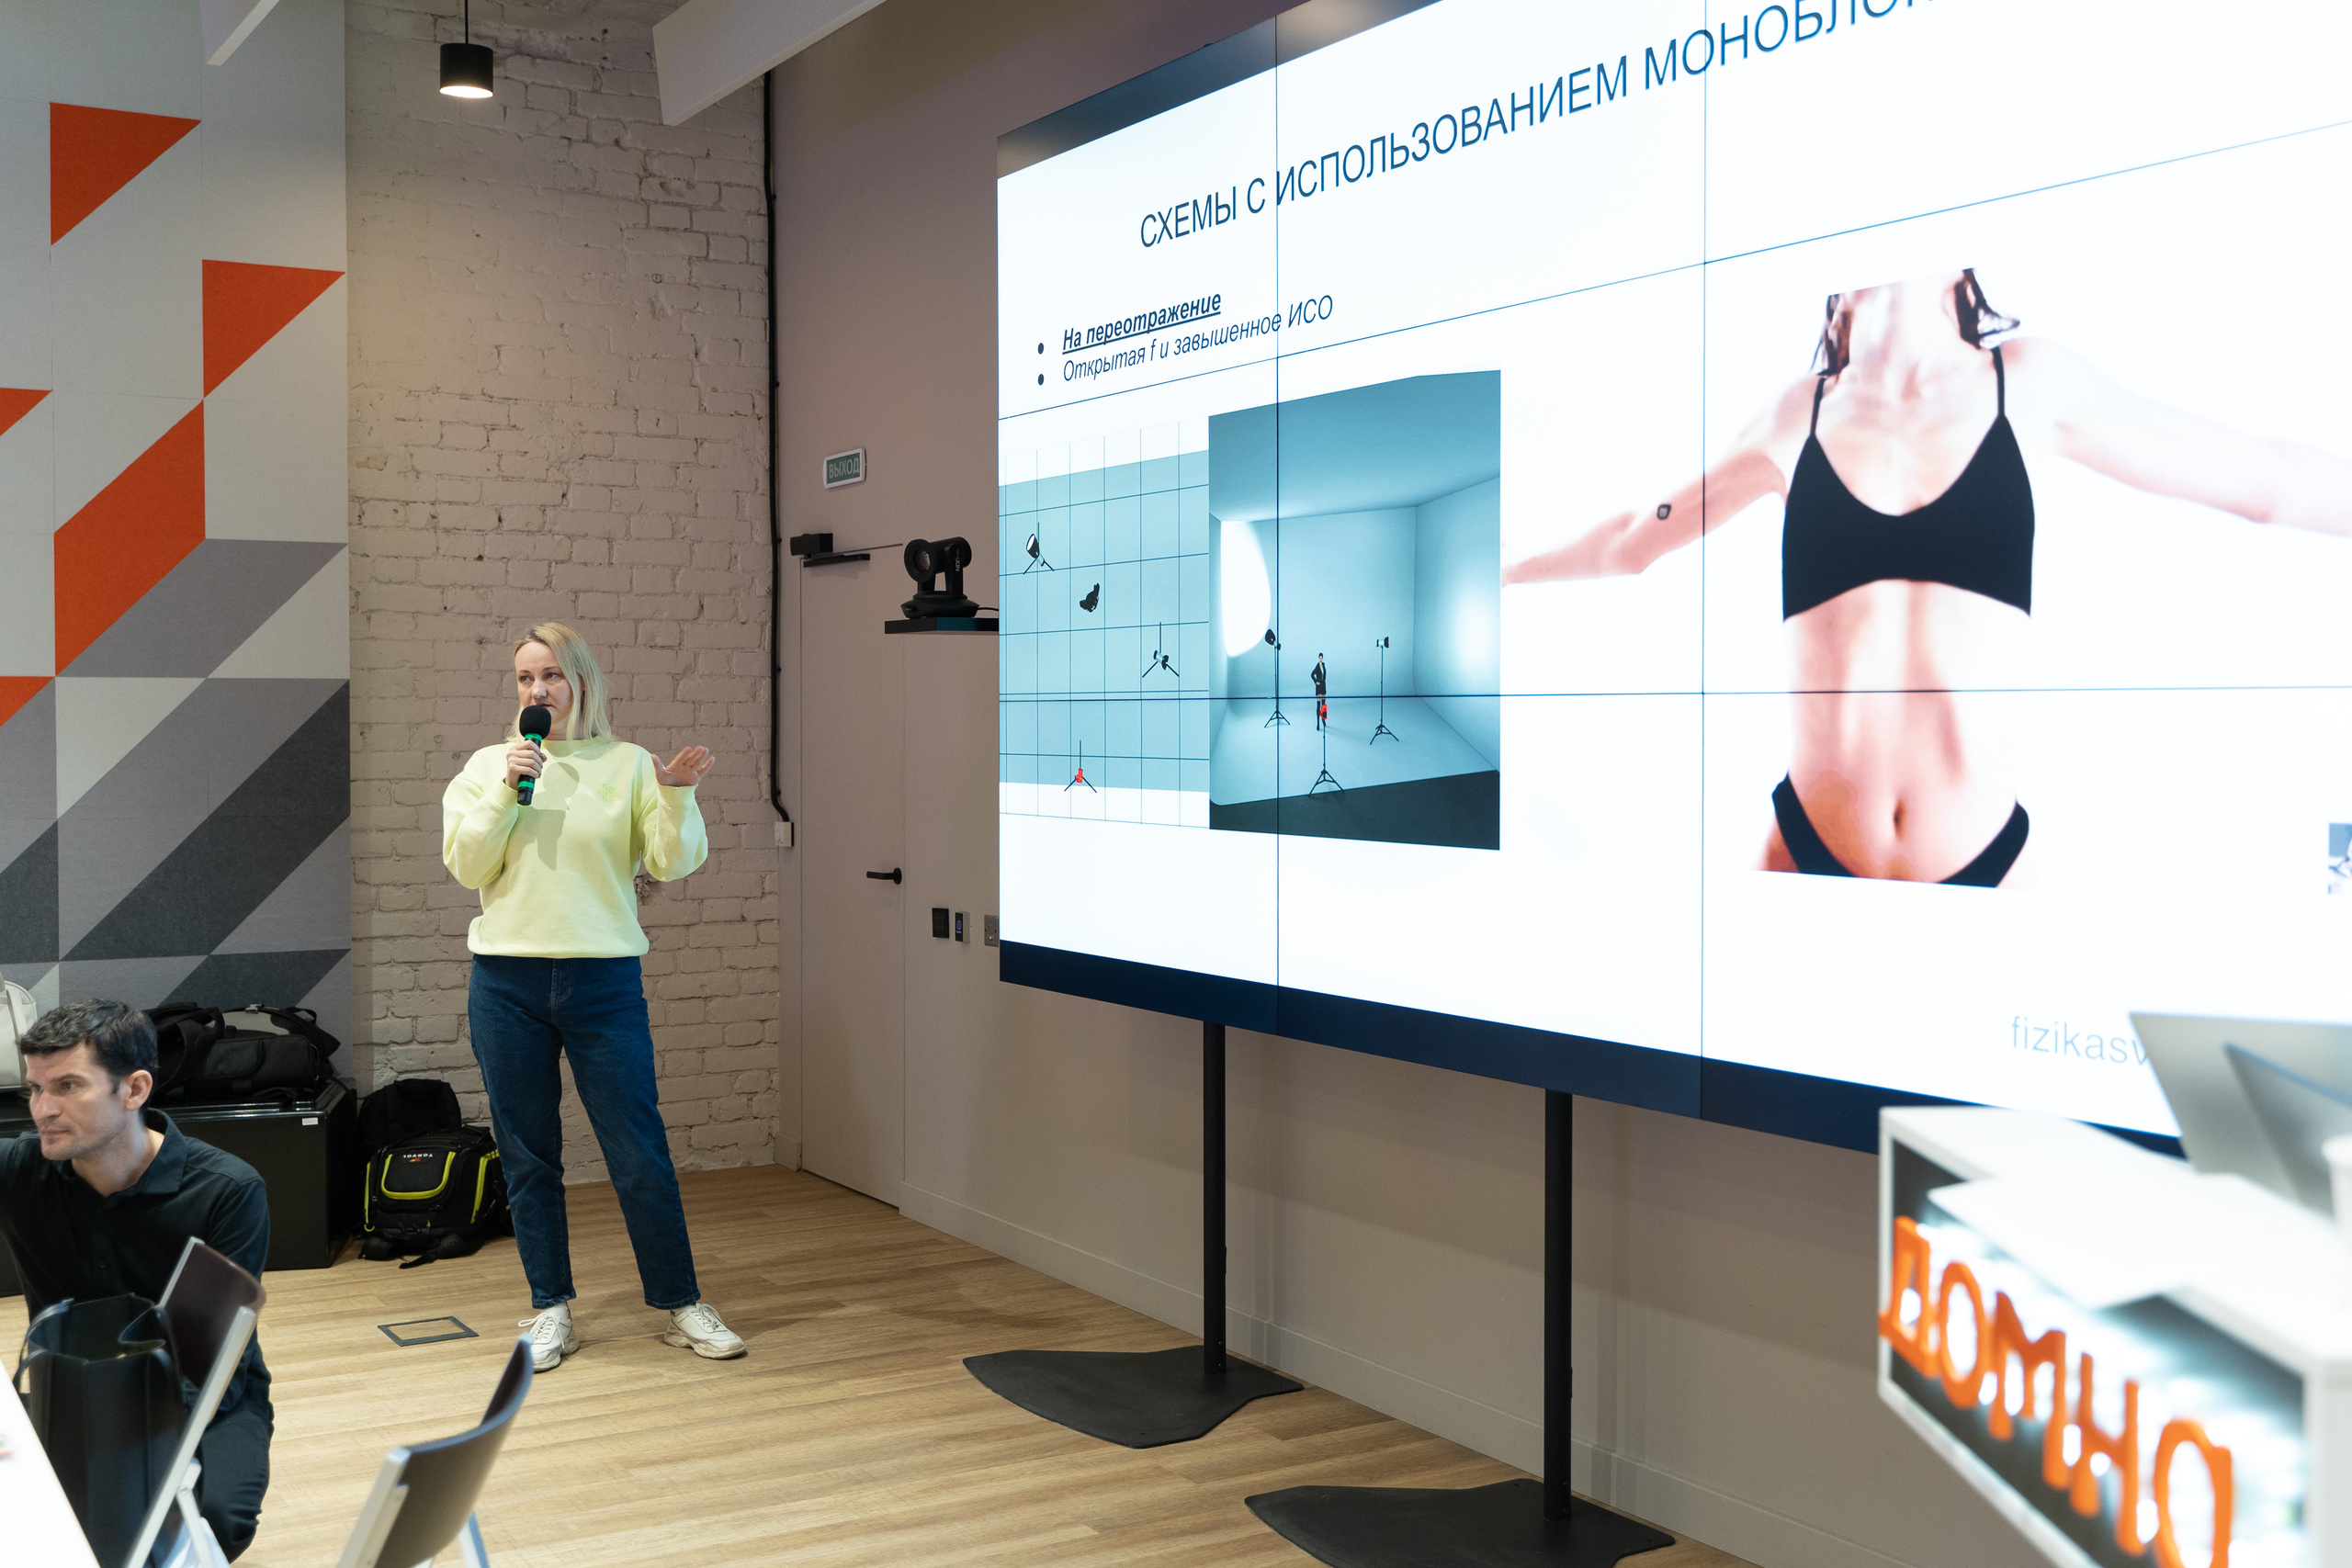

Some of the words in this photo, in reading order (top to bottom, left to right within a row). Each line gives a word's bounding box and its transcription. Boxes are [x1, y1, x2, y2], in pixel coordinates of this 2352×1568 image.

[1140, 186, 1237, 248] СХЕМЫ
[1247, 177, 1266, 214] С
[1277, 55, 1629, 207] ИСПОЛЬЗОВАНИЕМ
[1062, 327, 1081, 355] На
[1086, 293, 1221, 345] переотражение
[1063, 346, 1146, 381] Открытая
[1149, 338, 1158, 362] f
[1159, 341, 1170, 359] и
[1173, 313, 1282, 355] завышенное
[1288, 295, 1333, 328] ИСО
[829, 457, 860, 479] ВЫХОД
